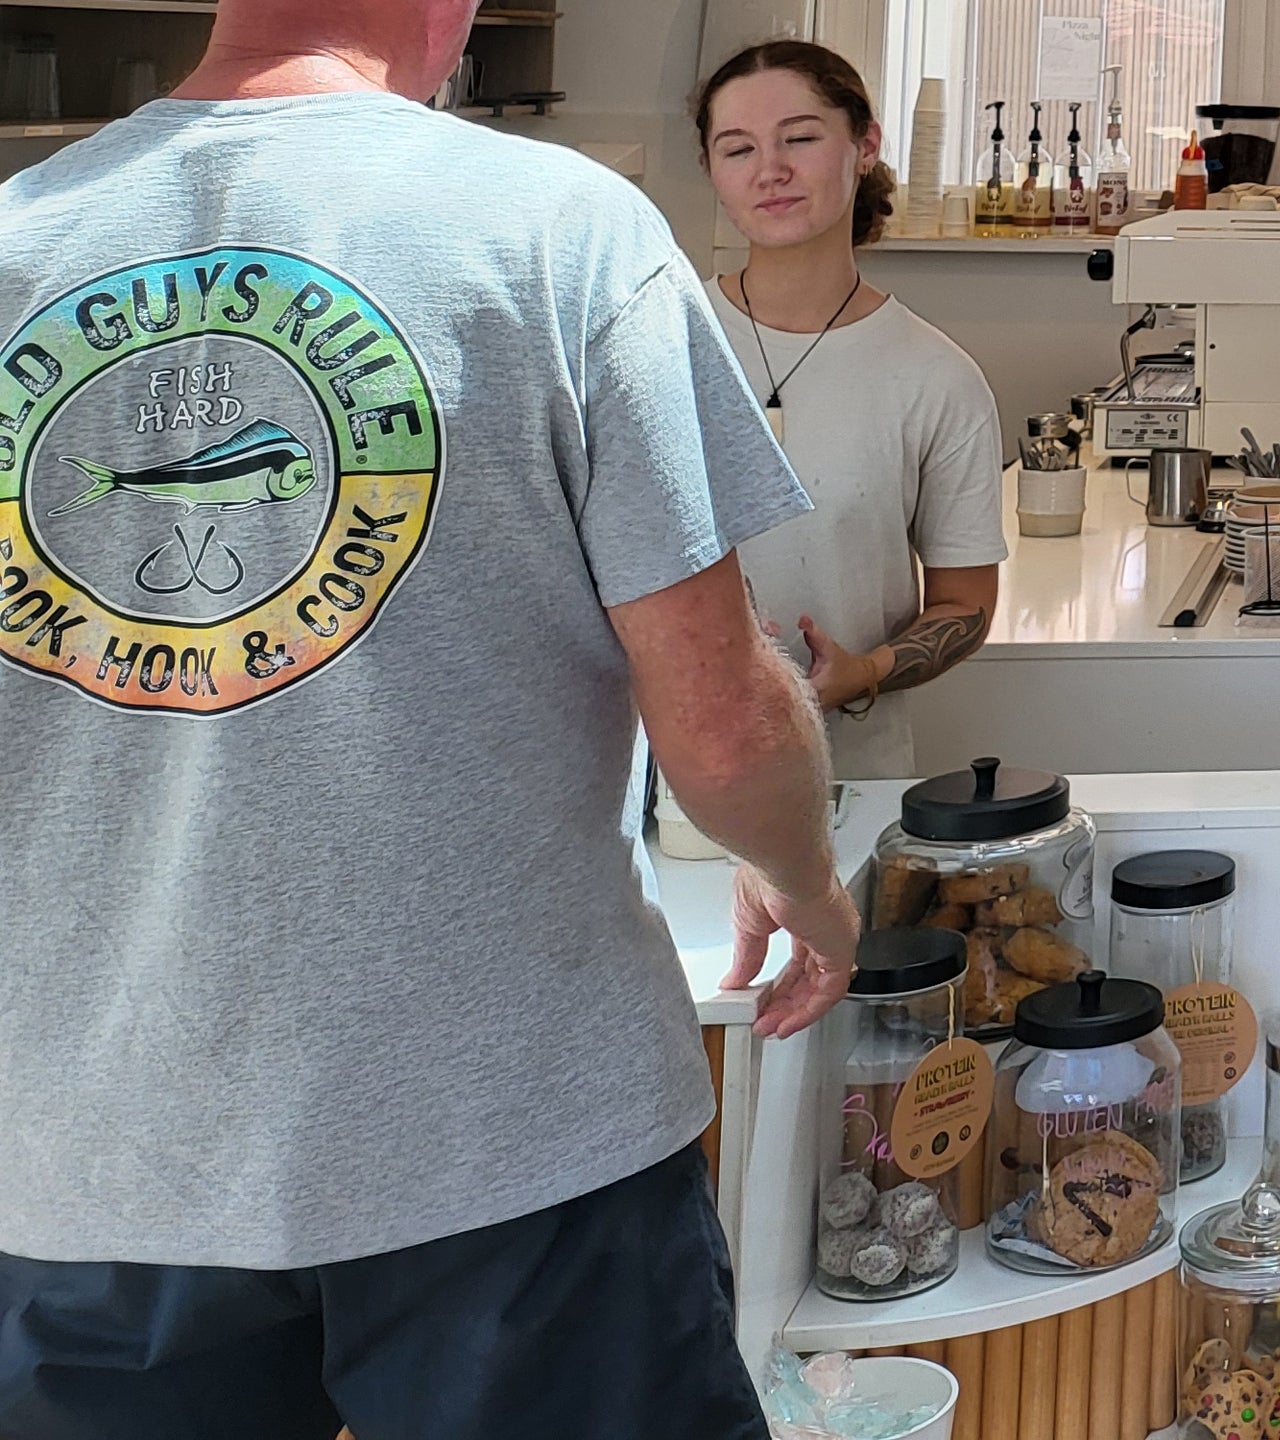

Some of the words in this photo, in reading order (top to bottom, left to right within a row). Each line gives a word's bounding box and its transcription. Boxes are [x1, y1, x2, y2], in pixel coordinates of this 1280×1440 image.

[75, 262, 268, 352] GUYS
[273, 282, 423, 450] RULE
[149, 362, 233, 398] FISH
[136, 396, 243, 433] HARD
[97, 635, 219, 697] HOOK
[243, 630, 296, 679] &
[297, 504, 408, 638] COOK
[915, 1054, 977, 1091] PROTEIN
